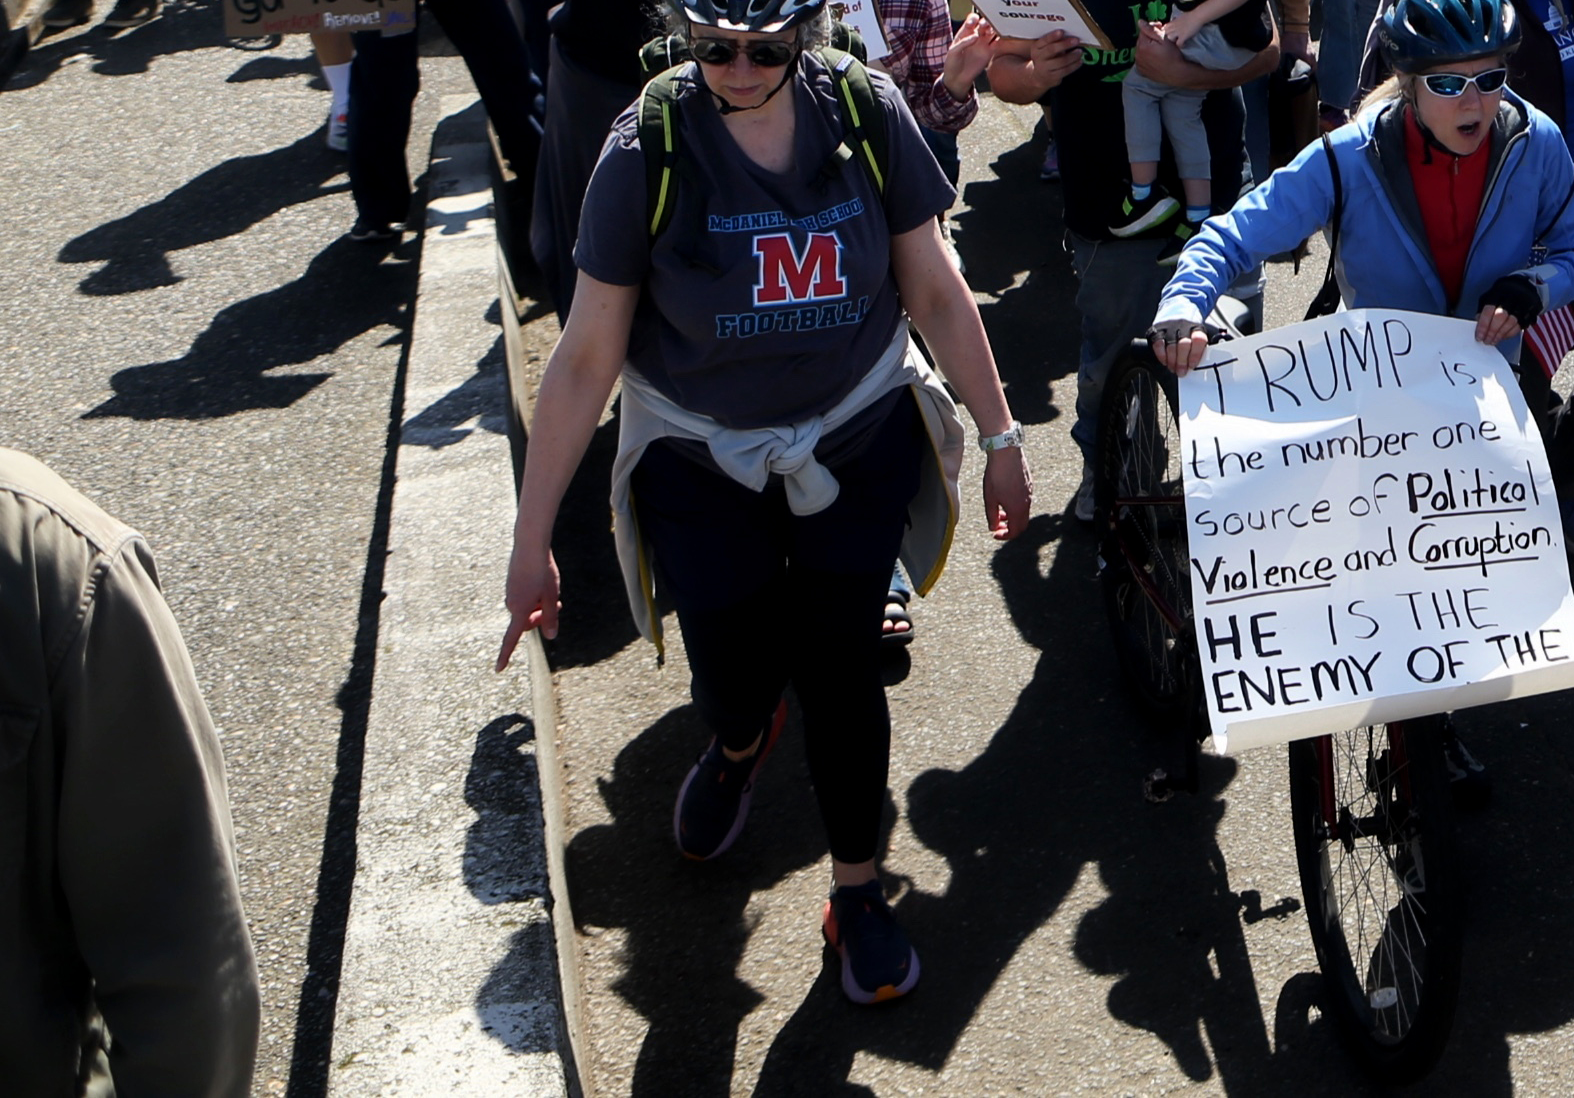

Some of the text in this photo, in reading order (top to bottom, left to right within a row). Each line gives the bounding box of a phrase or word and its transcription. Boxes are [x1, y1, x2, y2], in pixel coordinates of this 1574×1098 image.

[852, 0, 862, 12] of
[998, 9, 1066, 23] courage
[708, 211, 788, 232] McDANIEL
[752, 230, 848, 308] M
[716, 295, 870, 339] FOOTBALL
[1193, 319, 1477, 416] TRUMP is
[1188, 418, 1500, 480] the number one
[1193, 459, 1541, 537] source of Political
[1191, 520, 1558, 595] Violence and Corruption.
[1204, 588, 1499, 663] HE IS THE
[1212, 629, 1570, 714] ENEMY OF THE
